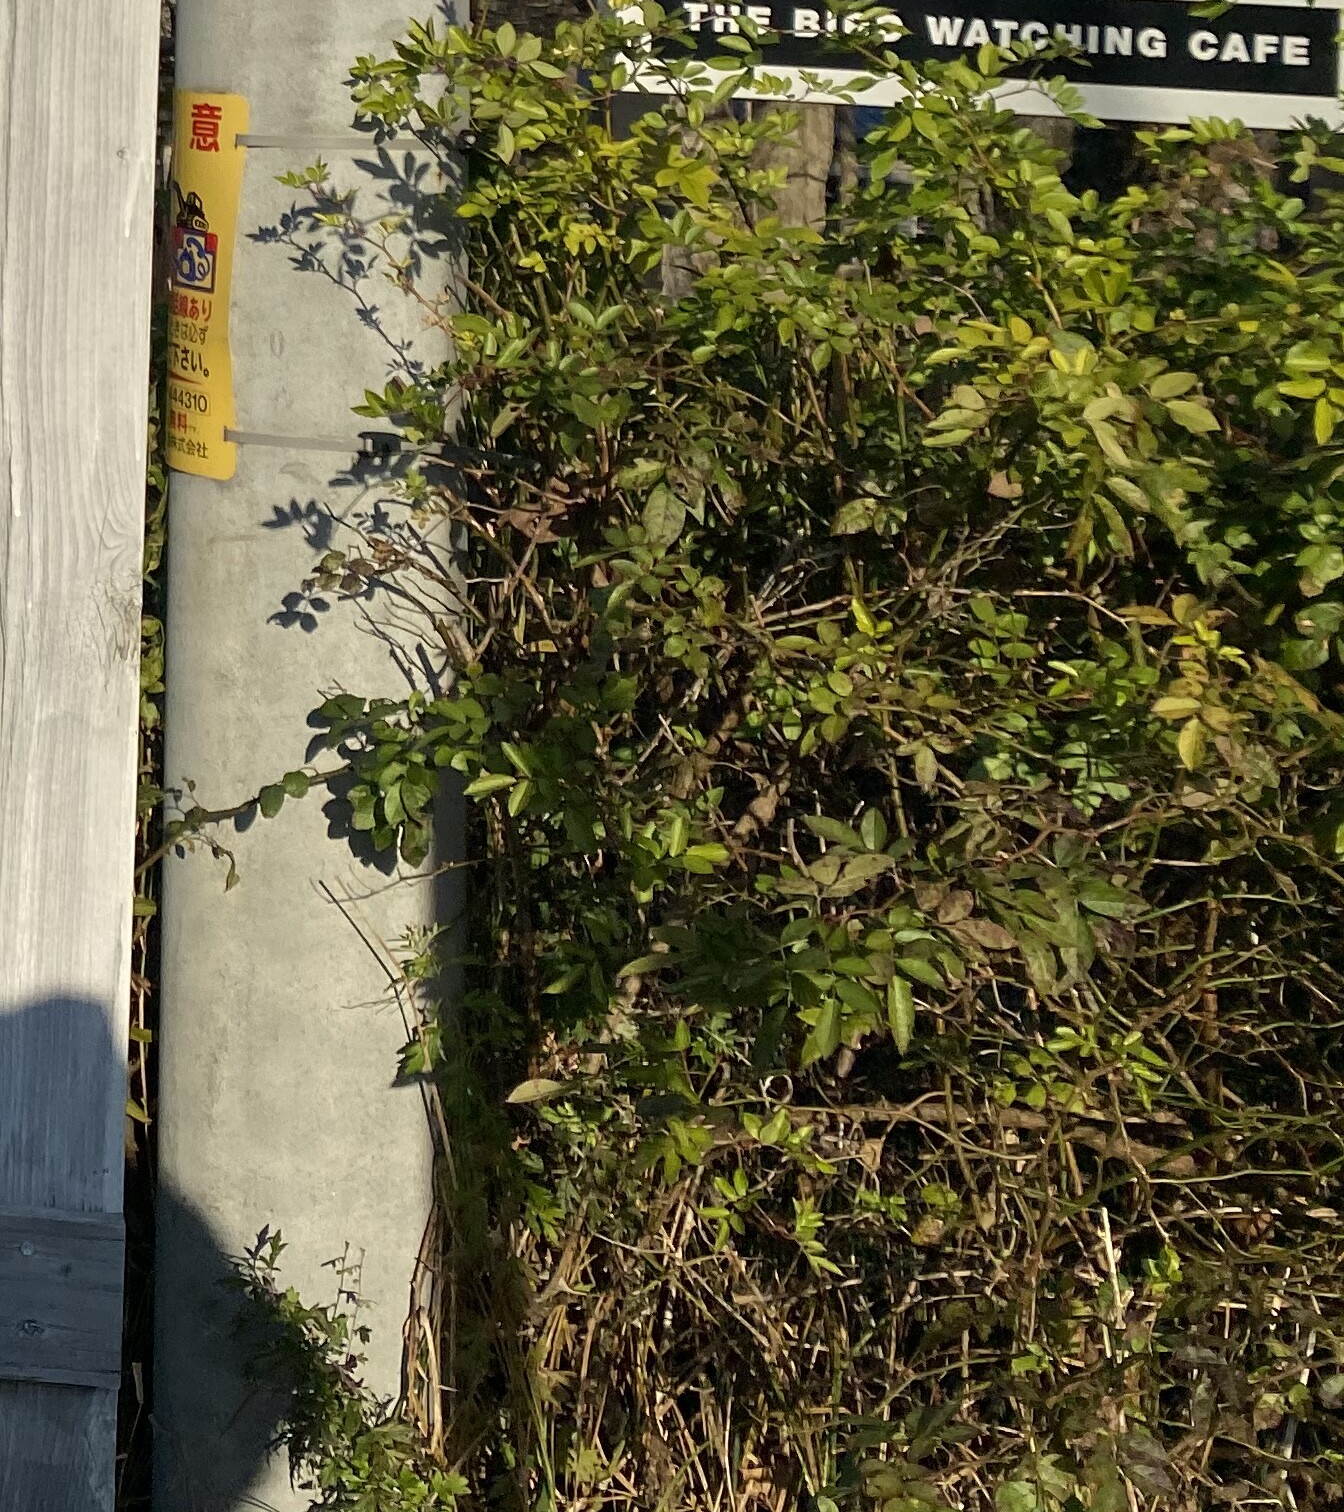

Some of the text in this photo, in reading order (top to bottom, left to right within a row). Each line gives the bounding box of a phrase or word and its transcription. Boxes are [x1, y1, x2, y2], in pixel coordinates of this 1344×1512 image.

[683, 1, 772, 35] THE
[925, 14, 1168, 59] WATCHING
[1188, 30, 1312, 66] CAFE
[189, 103, 223, 153] 意
